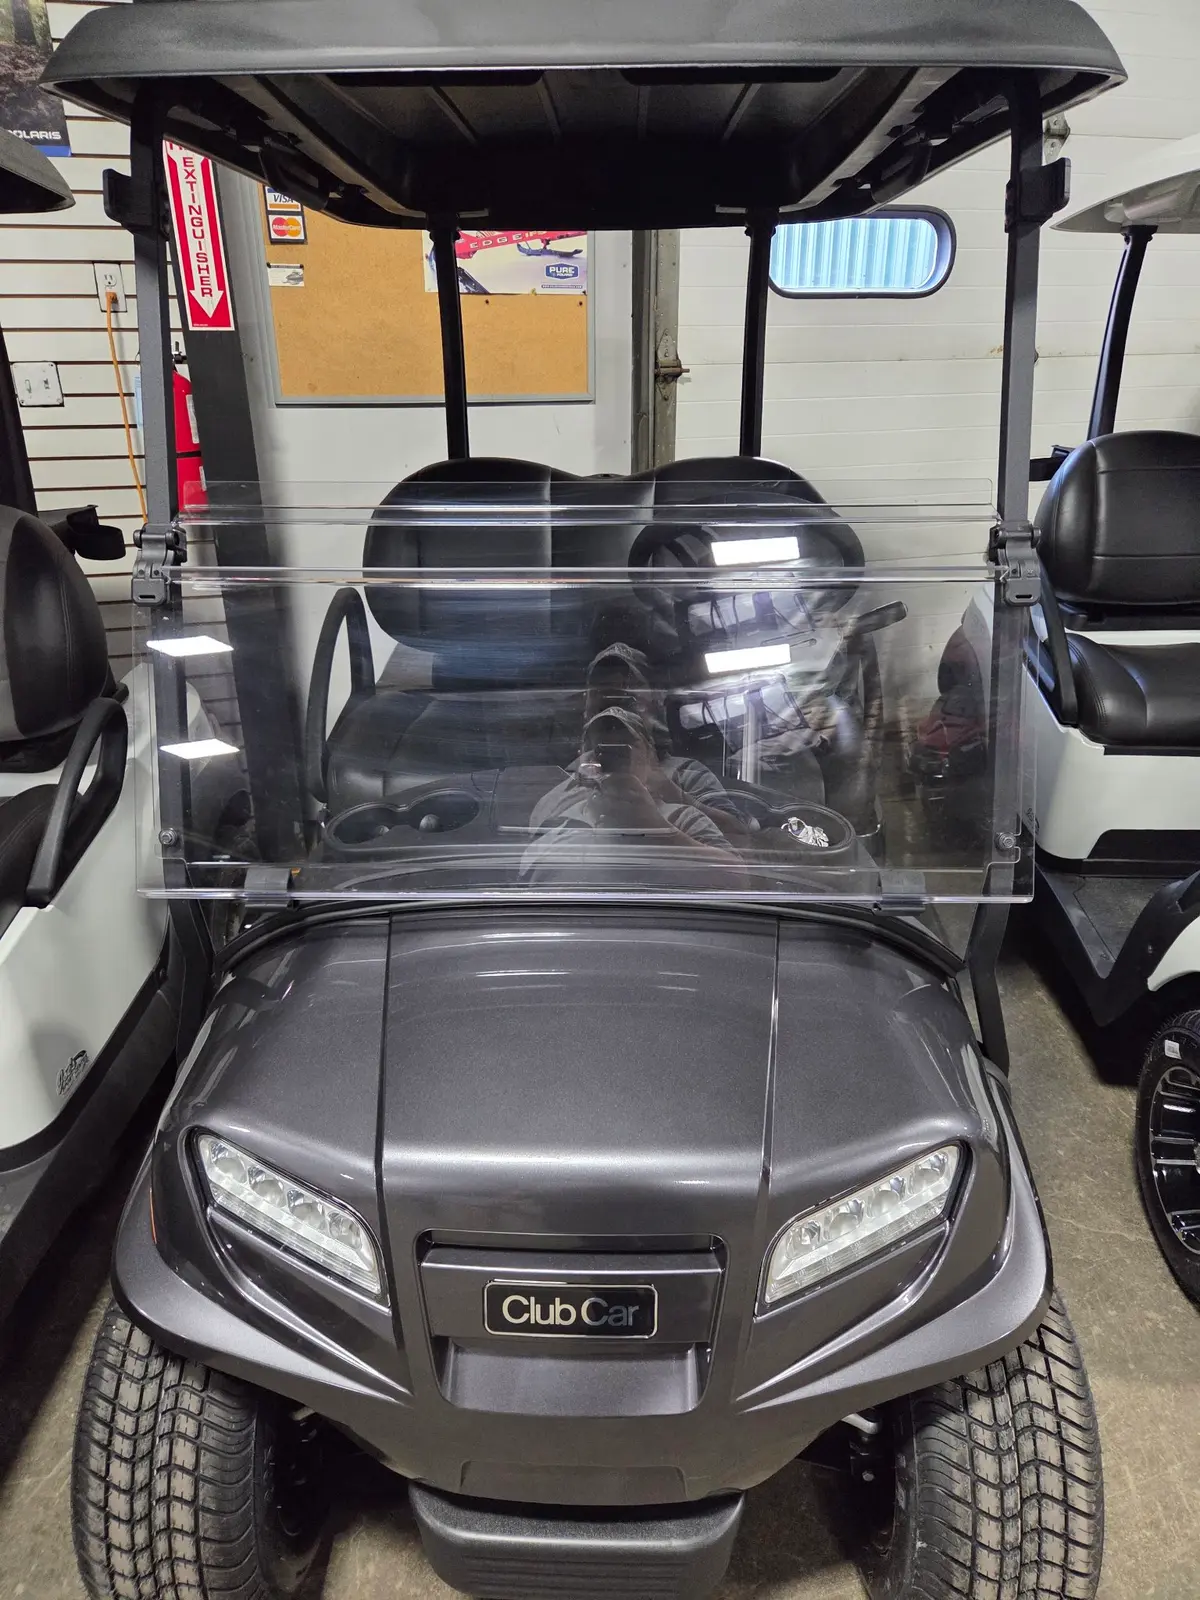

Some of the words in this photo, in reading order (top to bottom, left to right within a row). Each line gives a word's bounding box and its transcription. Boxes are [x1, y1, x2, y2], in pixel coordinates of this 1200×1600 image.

[8, 130, 61, 140] OLARIS
[182, 156, 213, 298] EXTINGUISHER
[470, 233, 523, 249] EDGE
[549, 266, 575, 275] PURE
[502, 1294, 577, 1326] Club
[580, 1297, 640, 1327] Car
